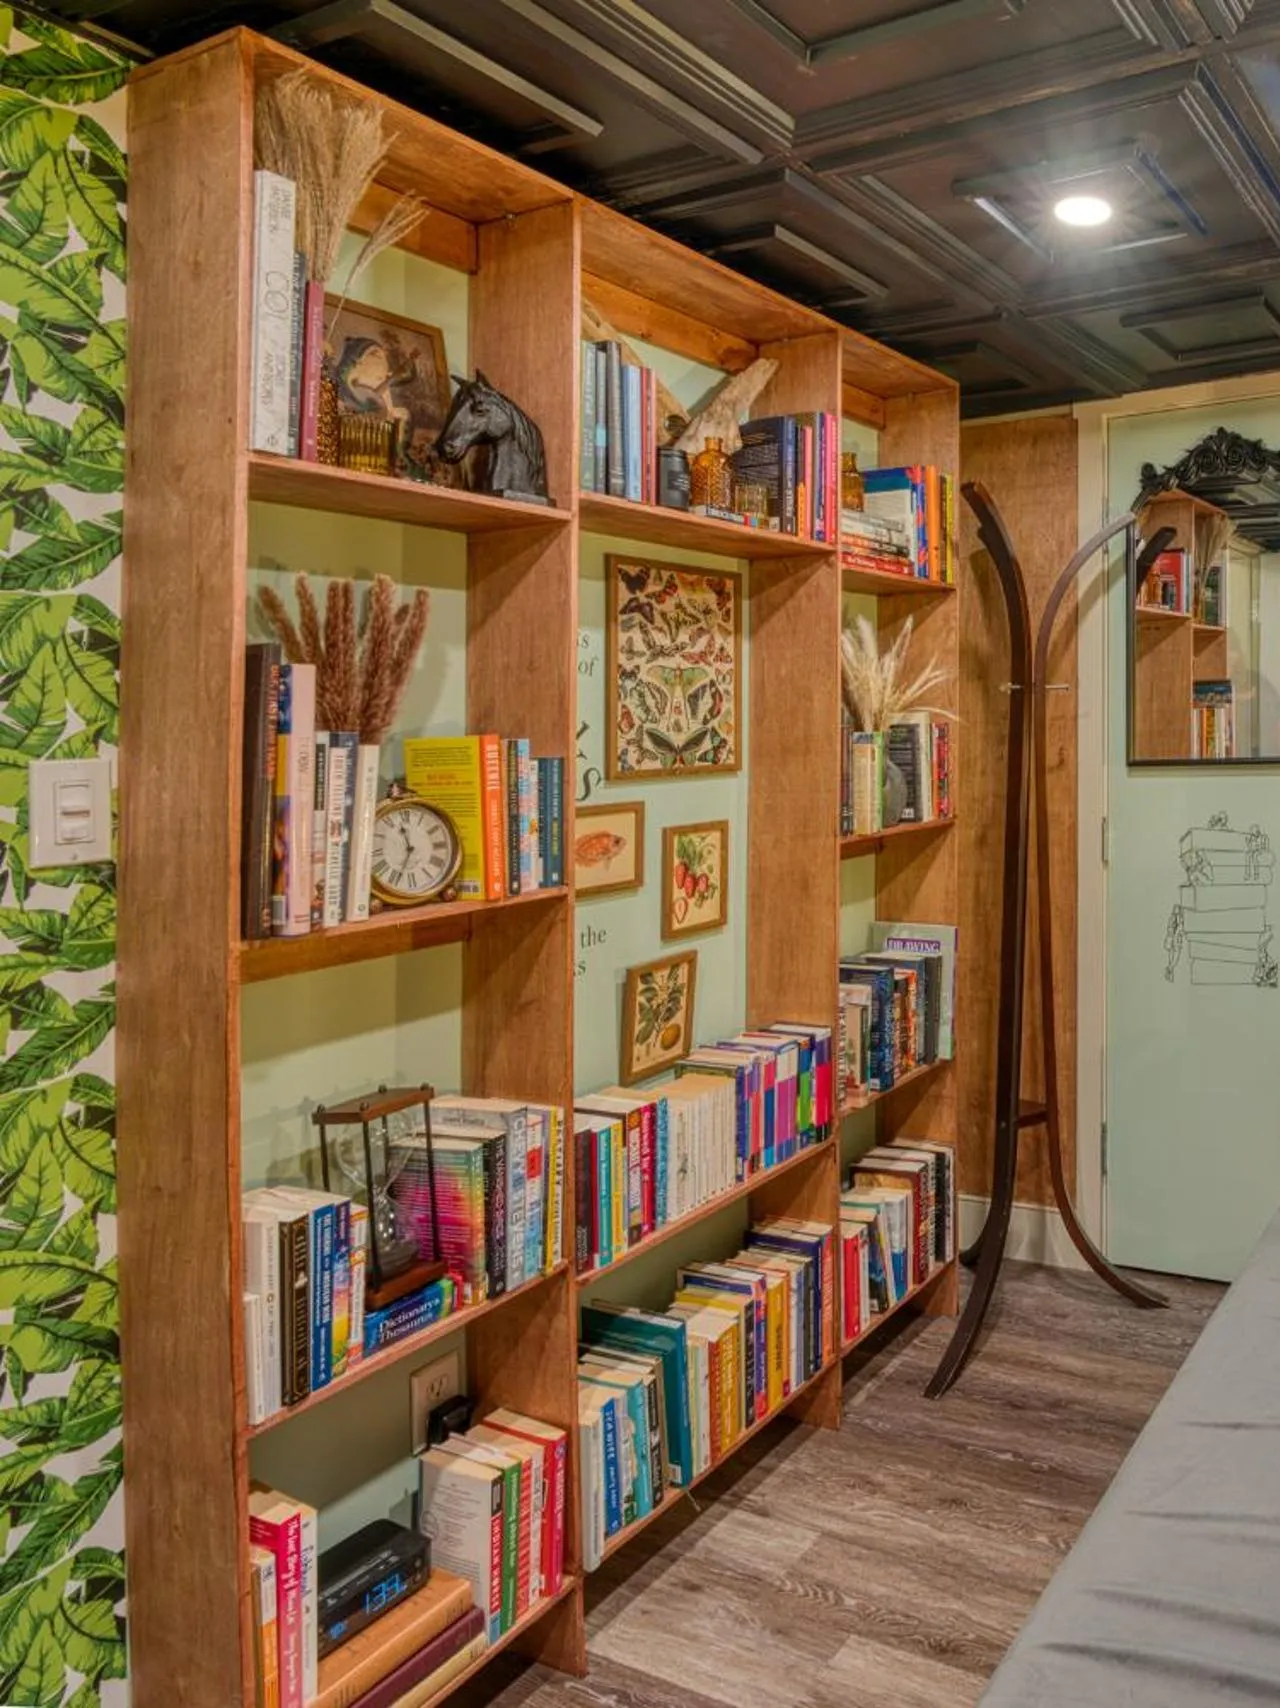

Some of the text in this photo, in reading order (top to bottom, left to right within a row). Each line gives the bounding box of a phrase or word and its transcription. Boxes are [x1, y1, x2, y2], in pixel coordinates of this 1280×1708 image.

[578, 657, 599, 678] of
[580, 924, 607, 949] the
[511, 1117, 526, 1269] CHEVY STEVENS
[491, 1568, 501, 1610] HORSE
